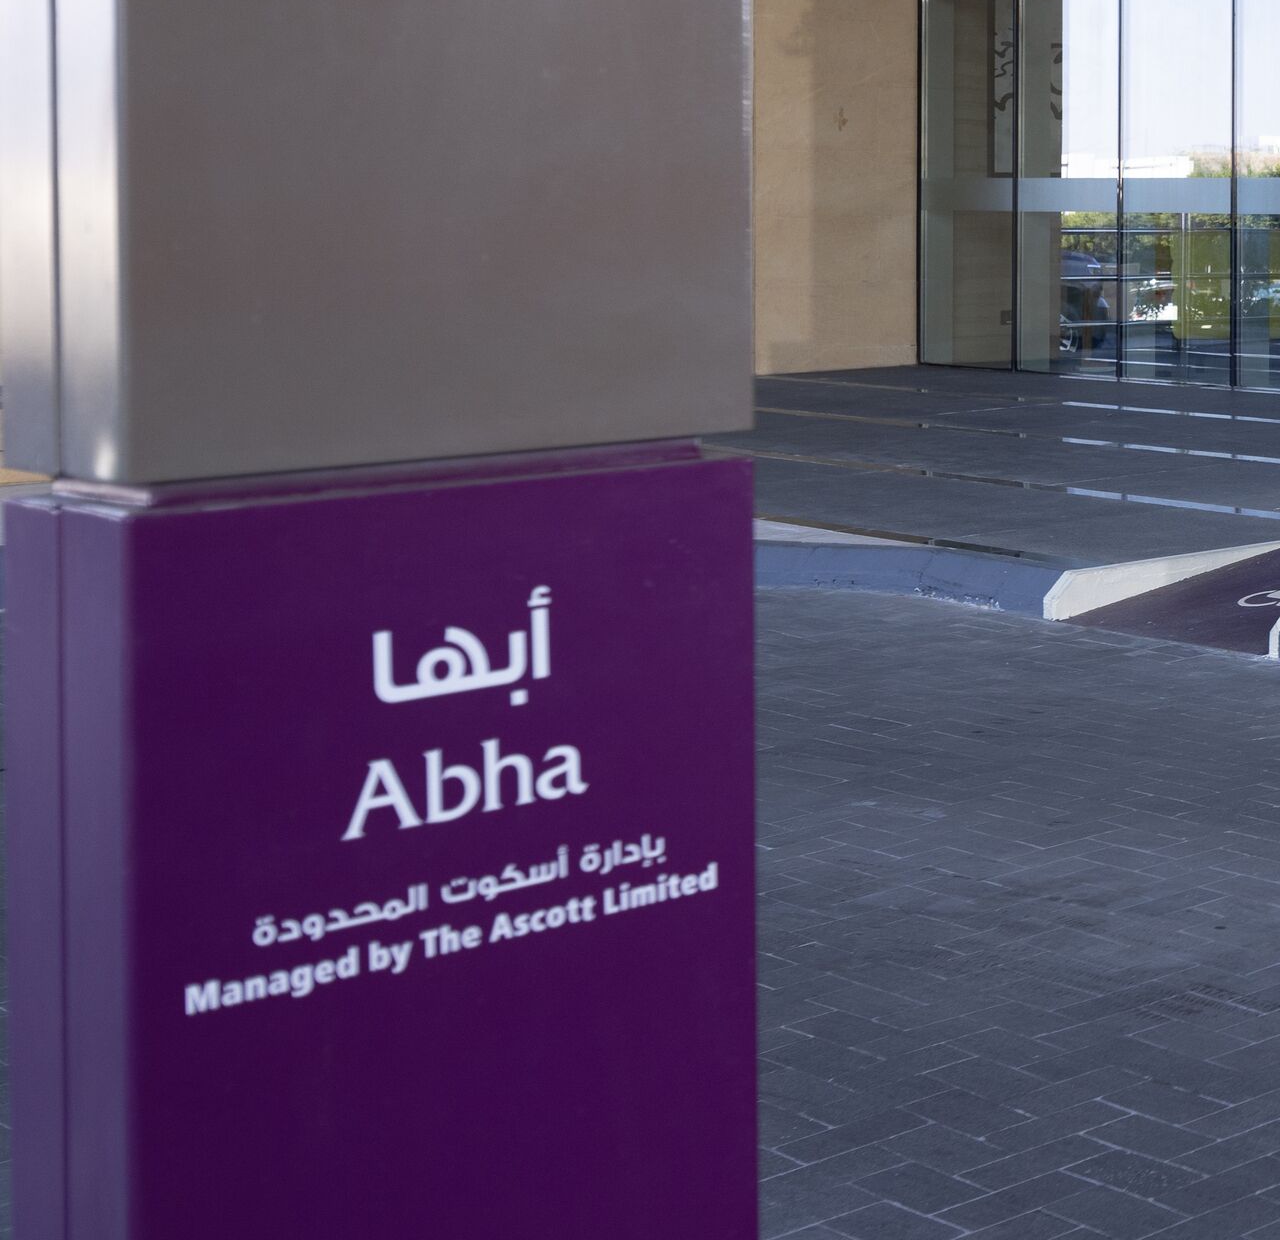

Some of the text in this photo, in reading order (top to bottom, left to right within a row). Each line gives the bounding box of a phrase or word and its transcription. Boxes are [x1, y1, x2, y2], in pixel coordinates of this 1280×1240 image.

[372, 585, 552, 706] أبها
[341, 737, 589, 841] Abha
[184, 861, 719, 1016] Managed by The Ascott Limited
[252, 833, 667, 947] بإدارة أسكوت المحدودة
